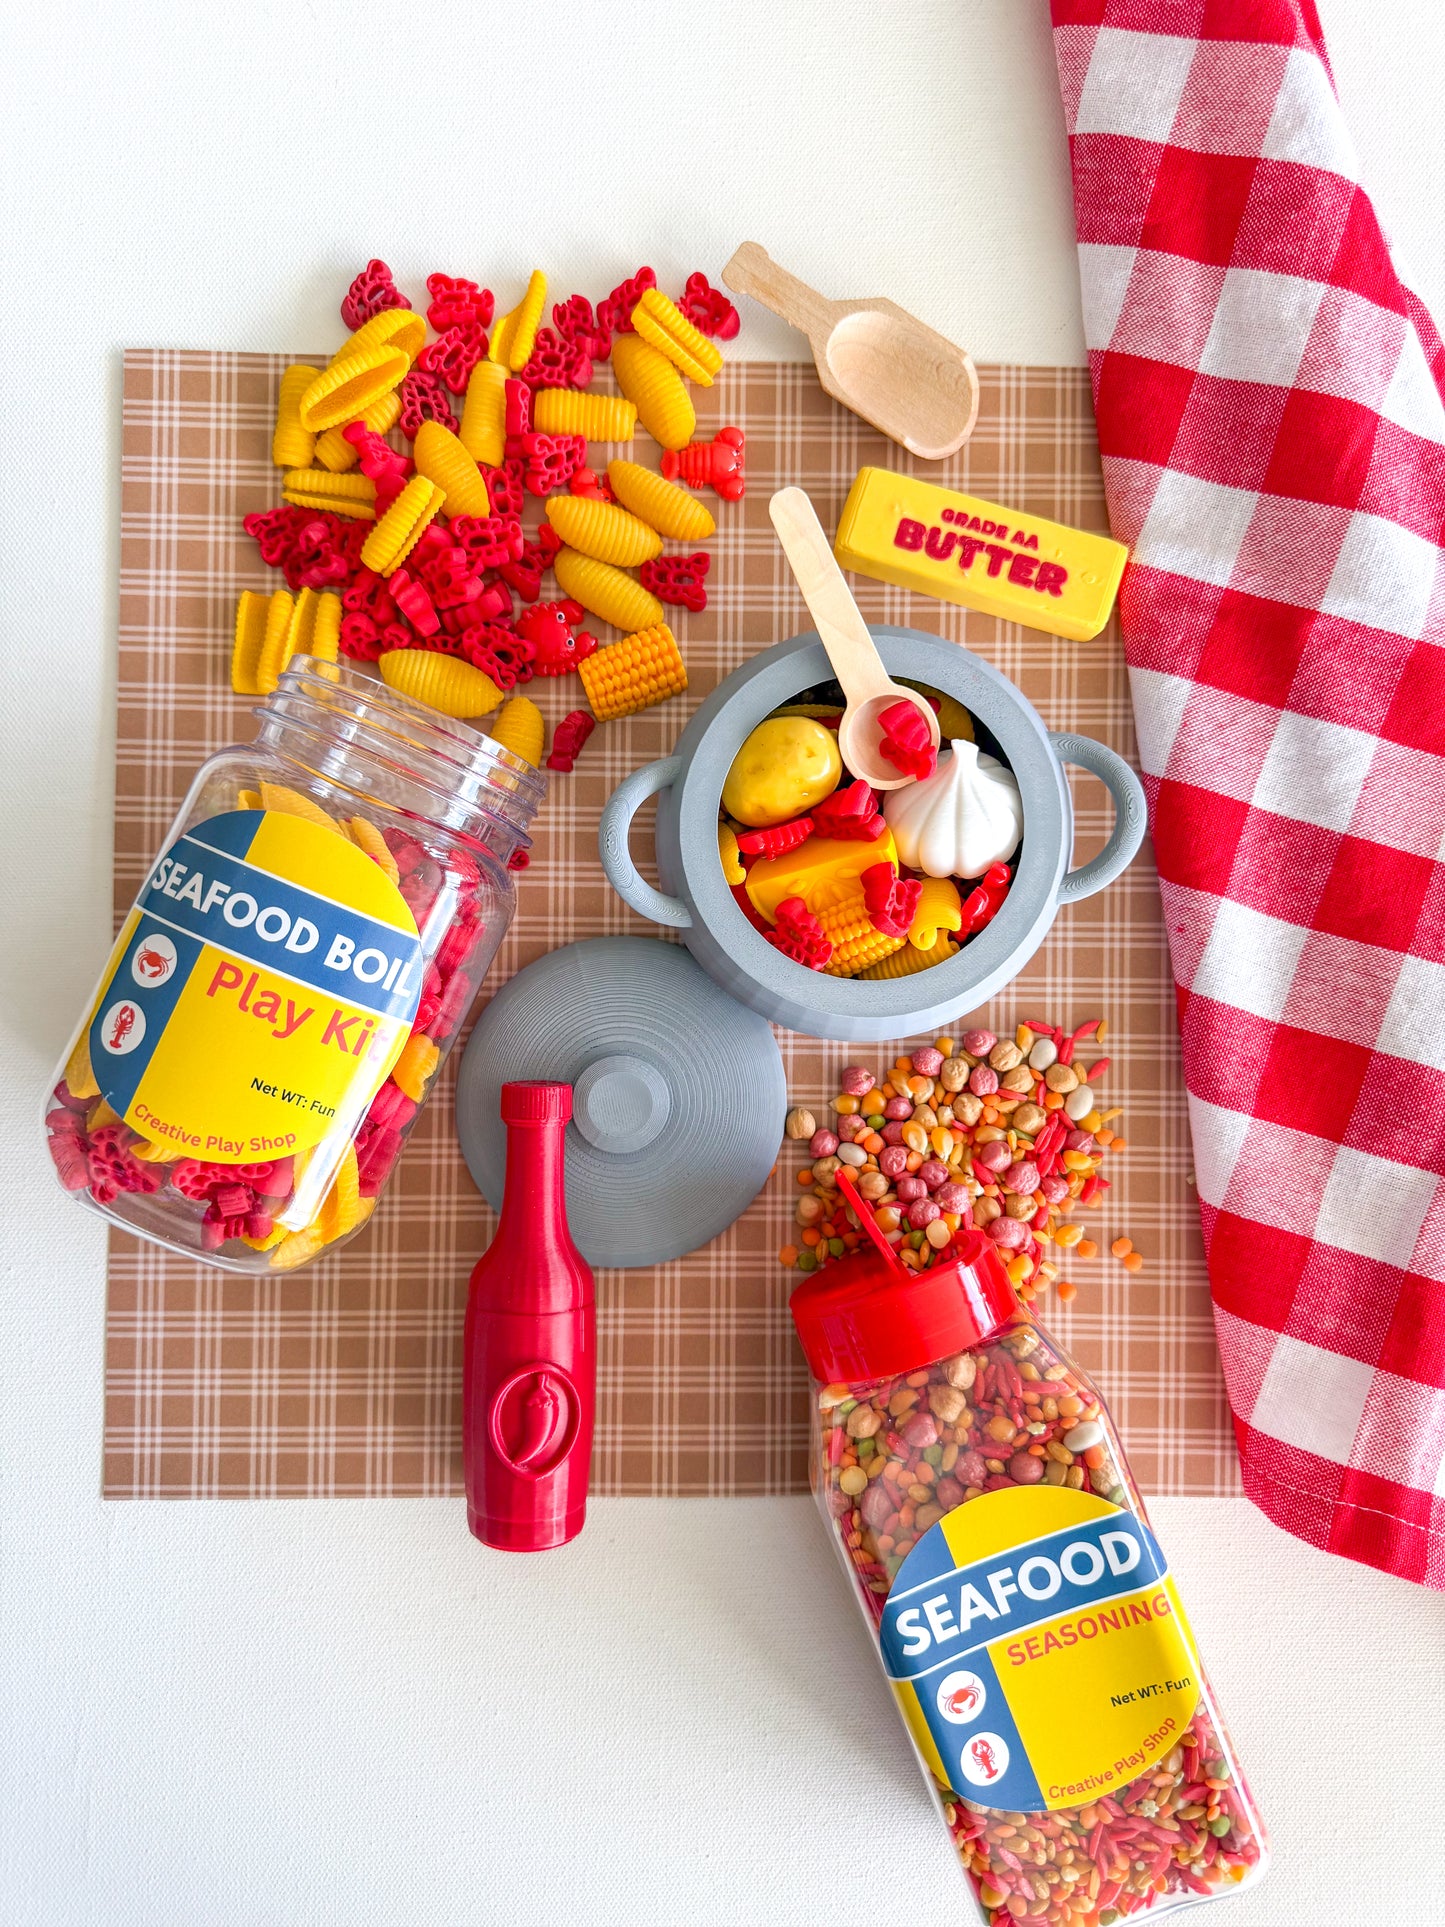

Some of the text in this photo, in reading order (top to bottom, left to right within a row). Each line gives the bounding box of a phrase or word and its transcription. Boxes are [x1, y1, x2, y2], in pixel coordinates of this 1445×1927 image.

[894, 517, 1069, 598] BUTTER
[941, 508, 1039, 551] GRADE AA
[152, 857, 413, 999] SEAFOOD BOIL
[206, 961, 389, 1062] Play Kit
[134, 1103, 297, 1156] Creative Play Shop
[251, 1077, 336, 1118] Net WT: Fun
[895, 1530, 1141, 1656] SEAFOOD
[1007, 1593, 1171, 1667] SEASONING
[1111, 1677, 1191, 1707] Net WT: Fun
[1049, 1716, 1176, 1800] Creative Play Shop
